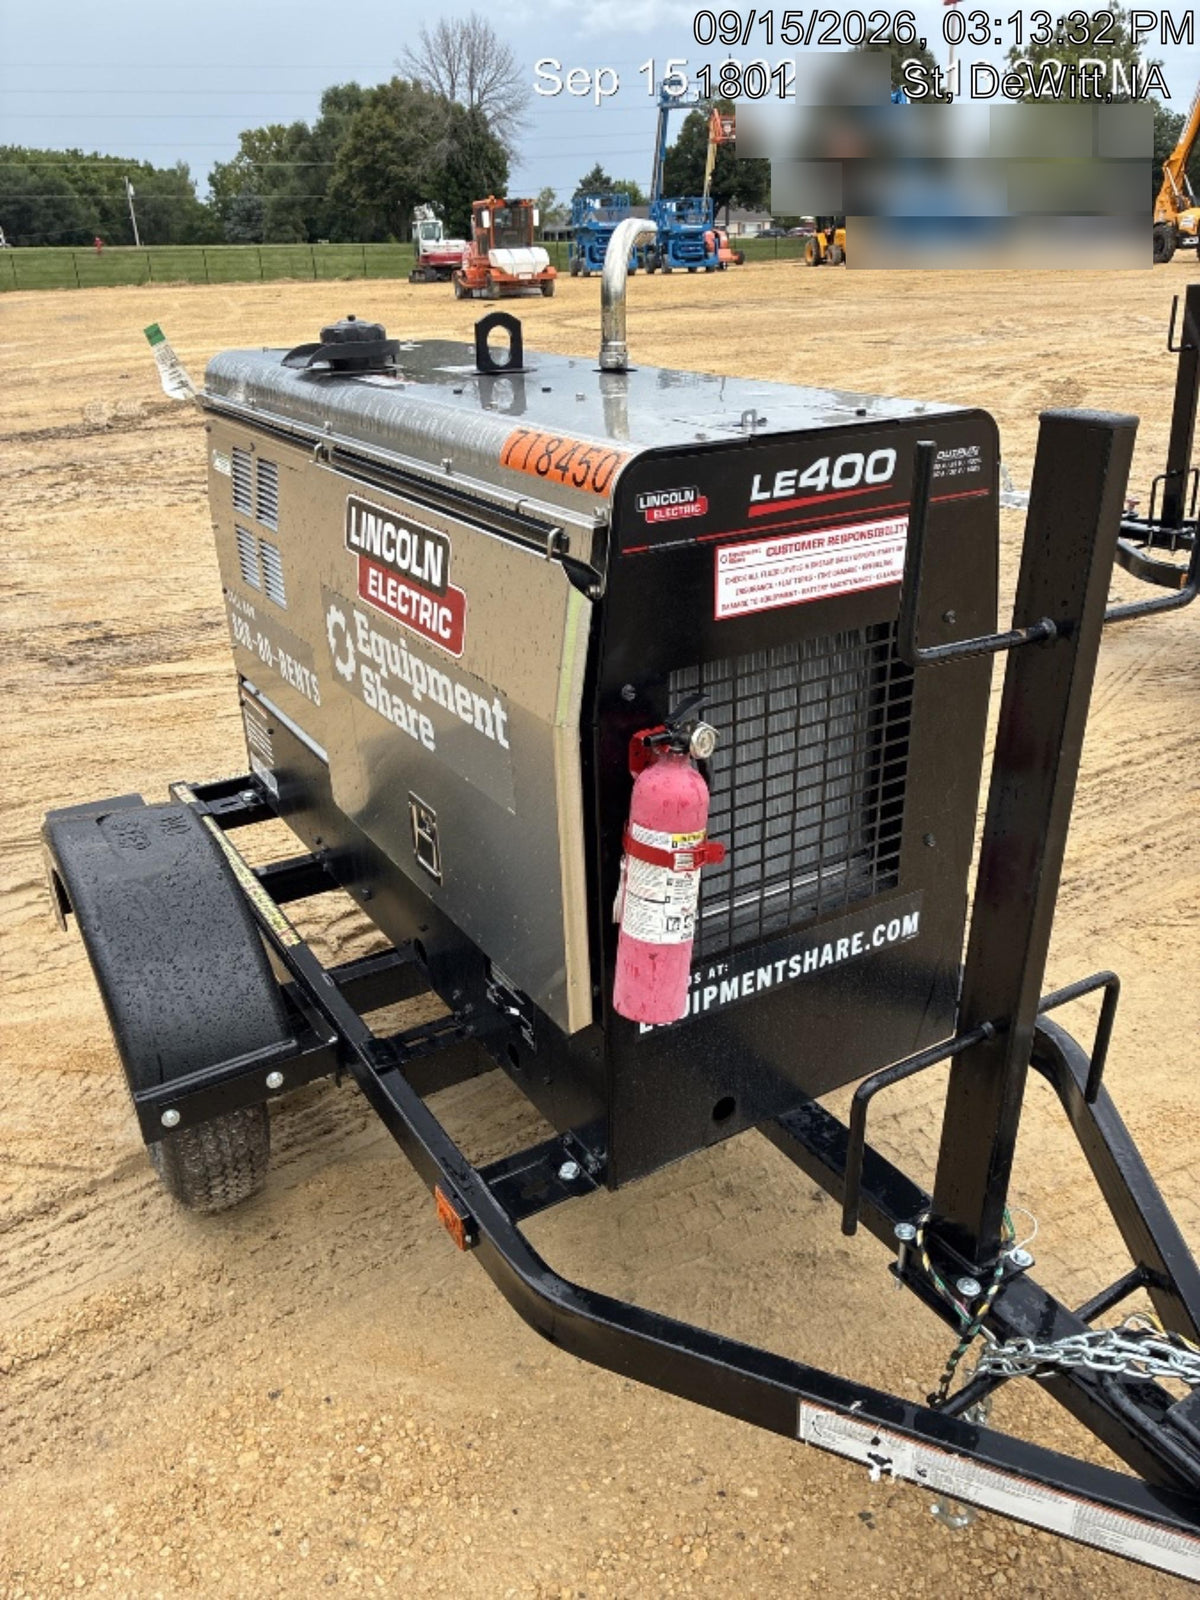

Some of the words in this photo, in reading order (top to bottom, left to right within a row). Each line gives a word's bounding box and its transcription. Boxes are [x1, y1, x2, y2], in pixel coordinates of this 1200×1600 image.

[639, 489, 695, 509] LINCOLN
[750, 447, 897, 502] LE400
[653, 503, 702, 520] ELECTRIC
[349, 504, 445, 588] LINCOLN
[766, 539, 825, 557] CUSTOMER
[367, 566, 453, 640] ELECTRIC
[353, 608, 510, 750] Equipment
[360, 664, 436, 752] Share
[708, 963, 729, 980] AT:
